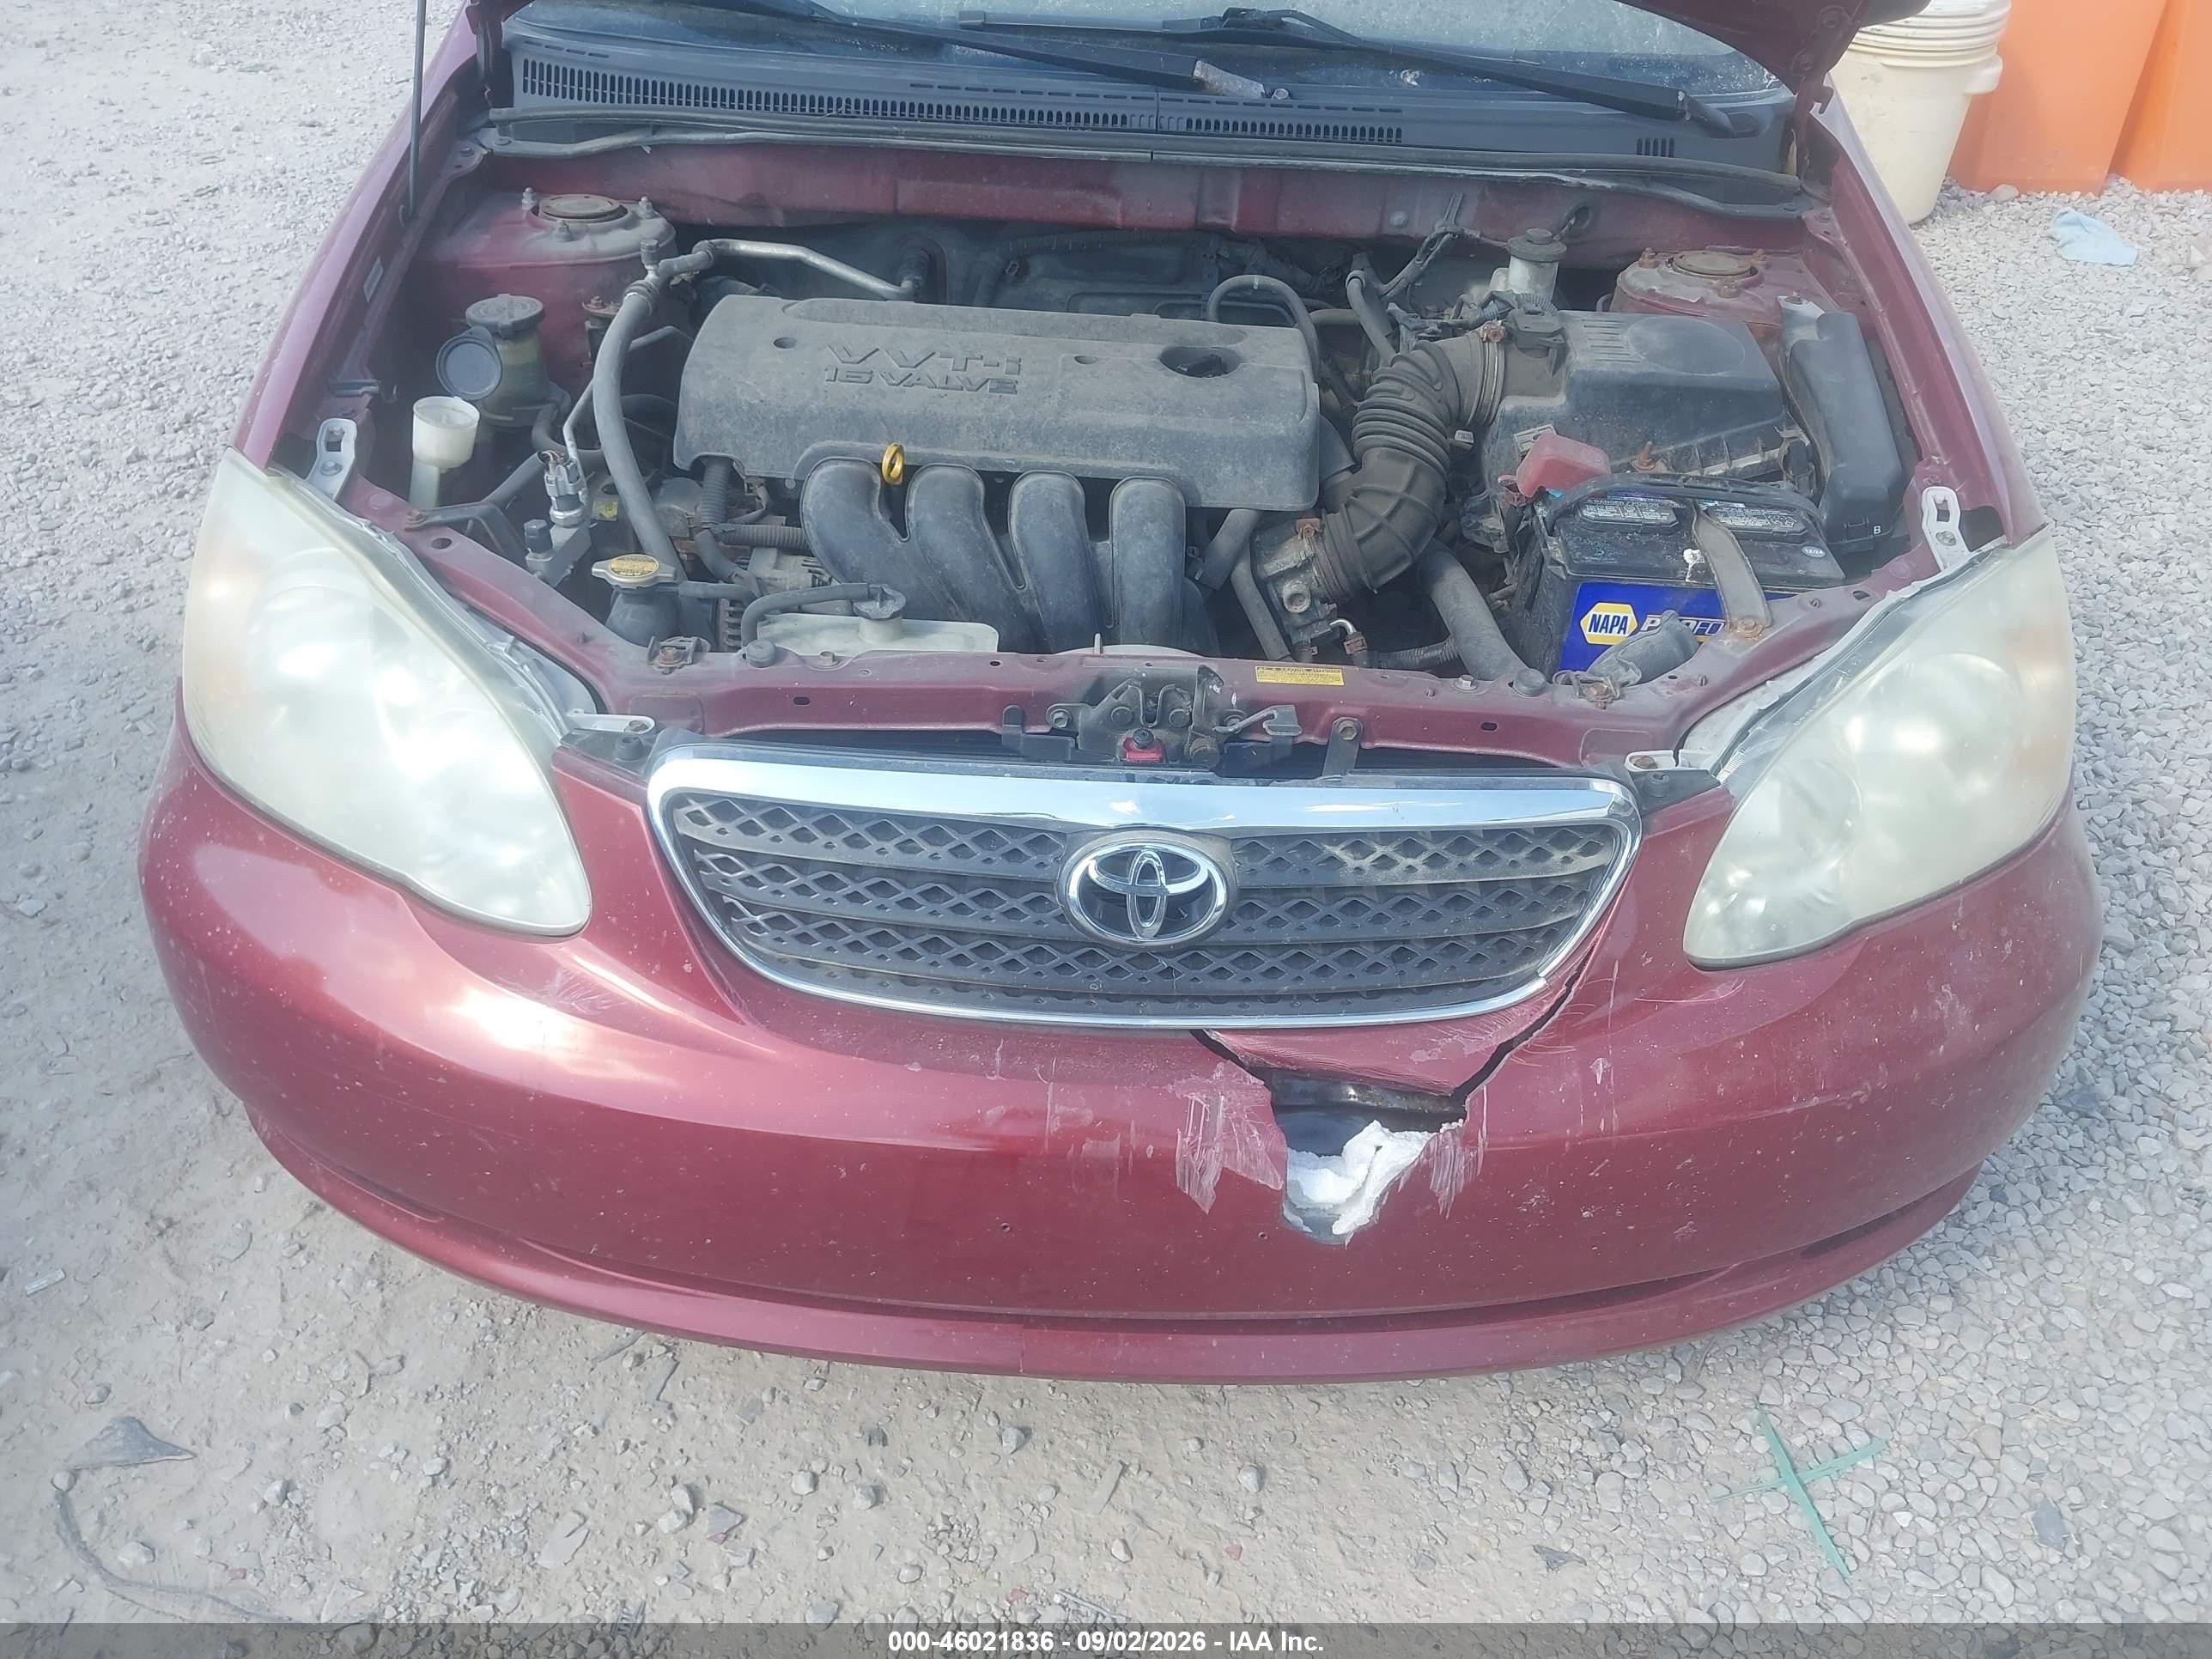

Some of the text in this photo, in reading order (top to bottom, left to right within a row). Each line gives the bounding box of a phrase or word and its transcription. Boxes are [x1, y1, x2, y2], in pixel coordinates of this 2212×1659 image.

[824, 367, 1018, 395] 16 VALVE
[1873, 526, 1881, 534] B
[1588, 613, 1629, 635] NAPA
